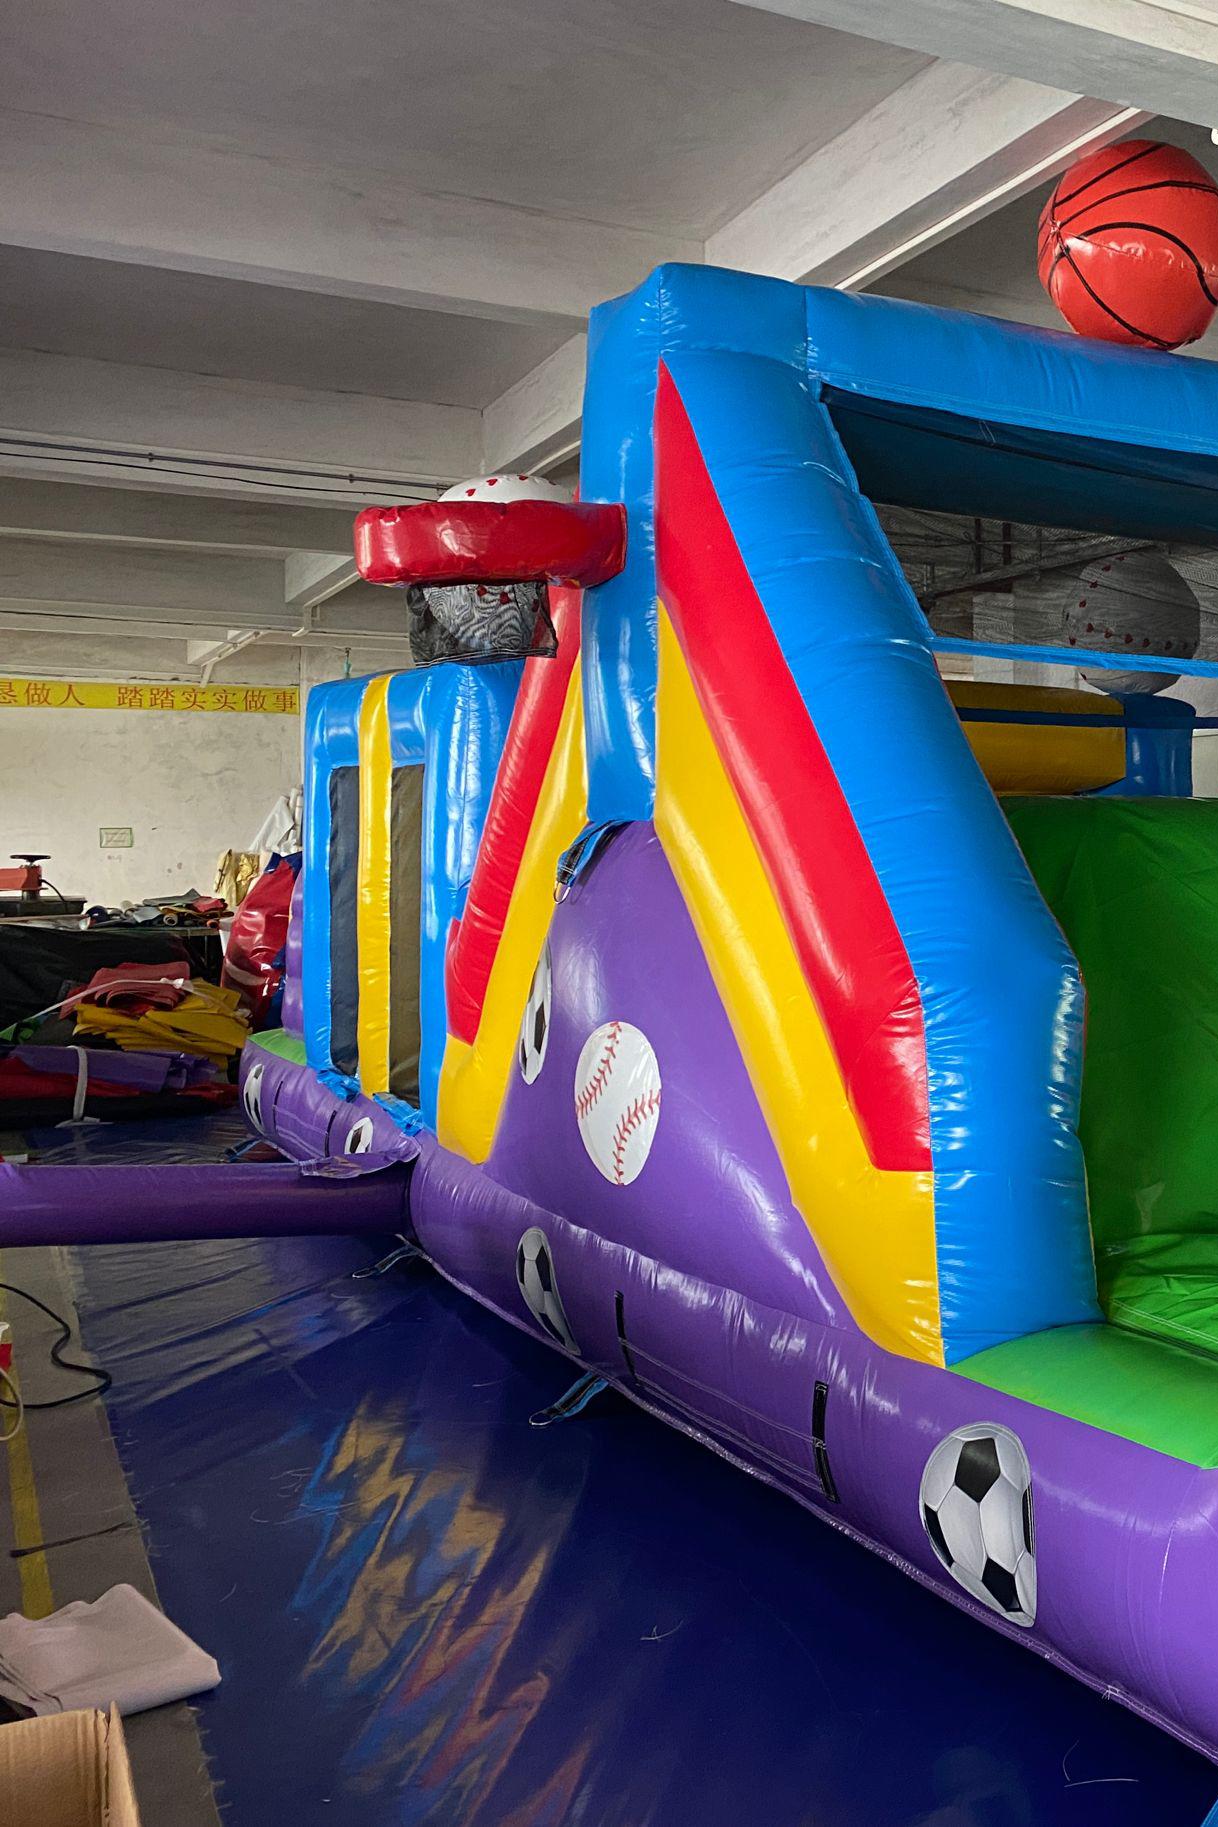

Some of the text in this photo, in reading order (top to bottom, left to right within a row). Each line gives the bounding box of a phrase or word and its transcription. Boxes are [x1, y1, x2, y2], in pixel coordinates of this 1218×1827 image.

[0, 681, 298, 713] 恳做人 踏踏实实做事
